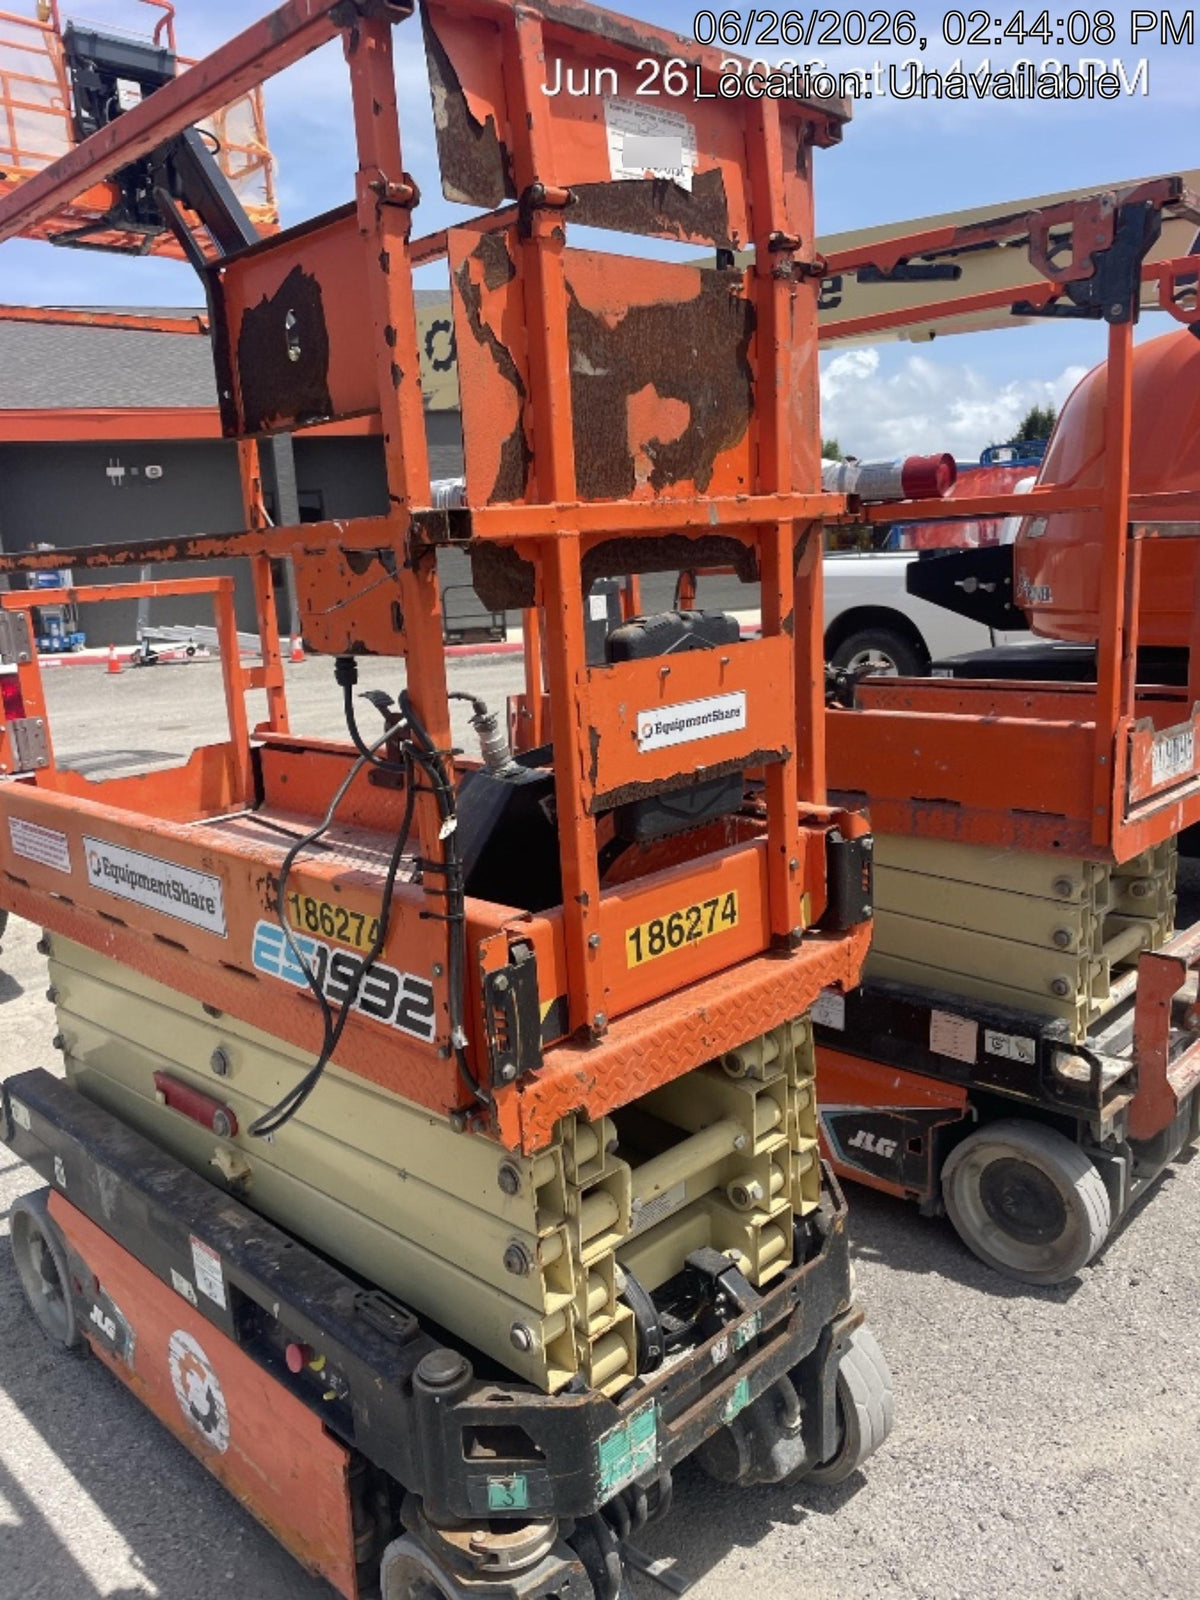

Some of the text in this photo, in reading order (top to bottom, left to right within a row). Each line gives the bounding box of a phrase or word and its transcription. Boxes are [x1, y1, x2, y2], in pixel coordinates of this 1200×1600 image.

[655, 708, 741, 735] EquipmentShare
[101, 856, 216, 914] EquipmentShare
[629, 892, 737, 962] 186274
[847, 1129, 898, 1158] JLG
